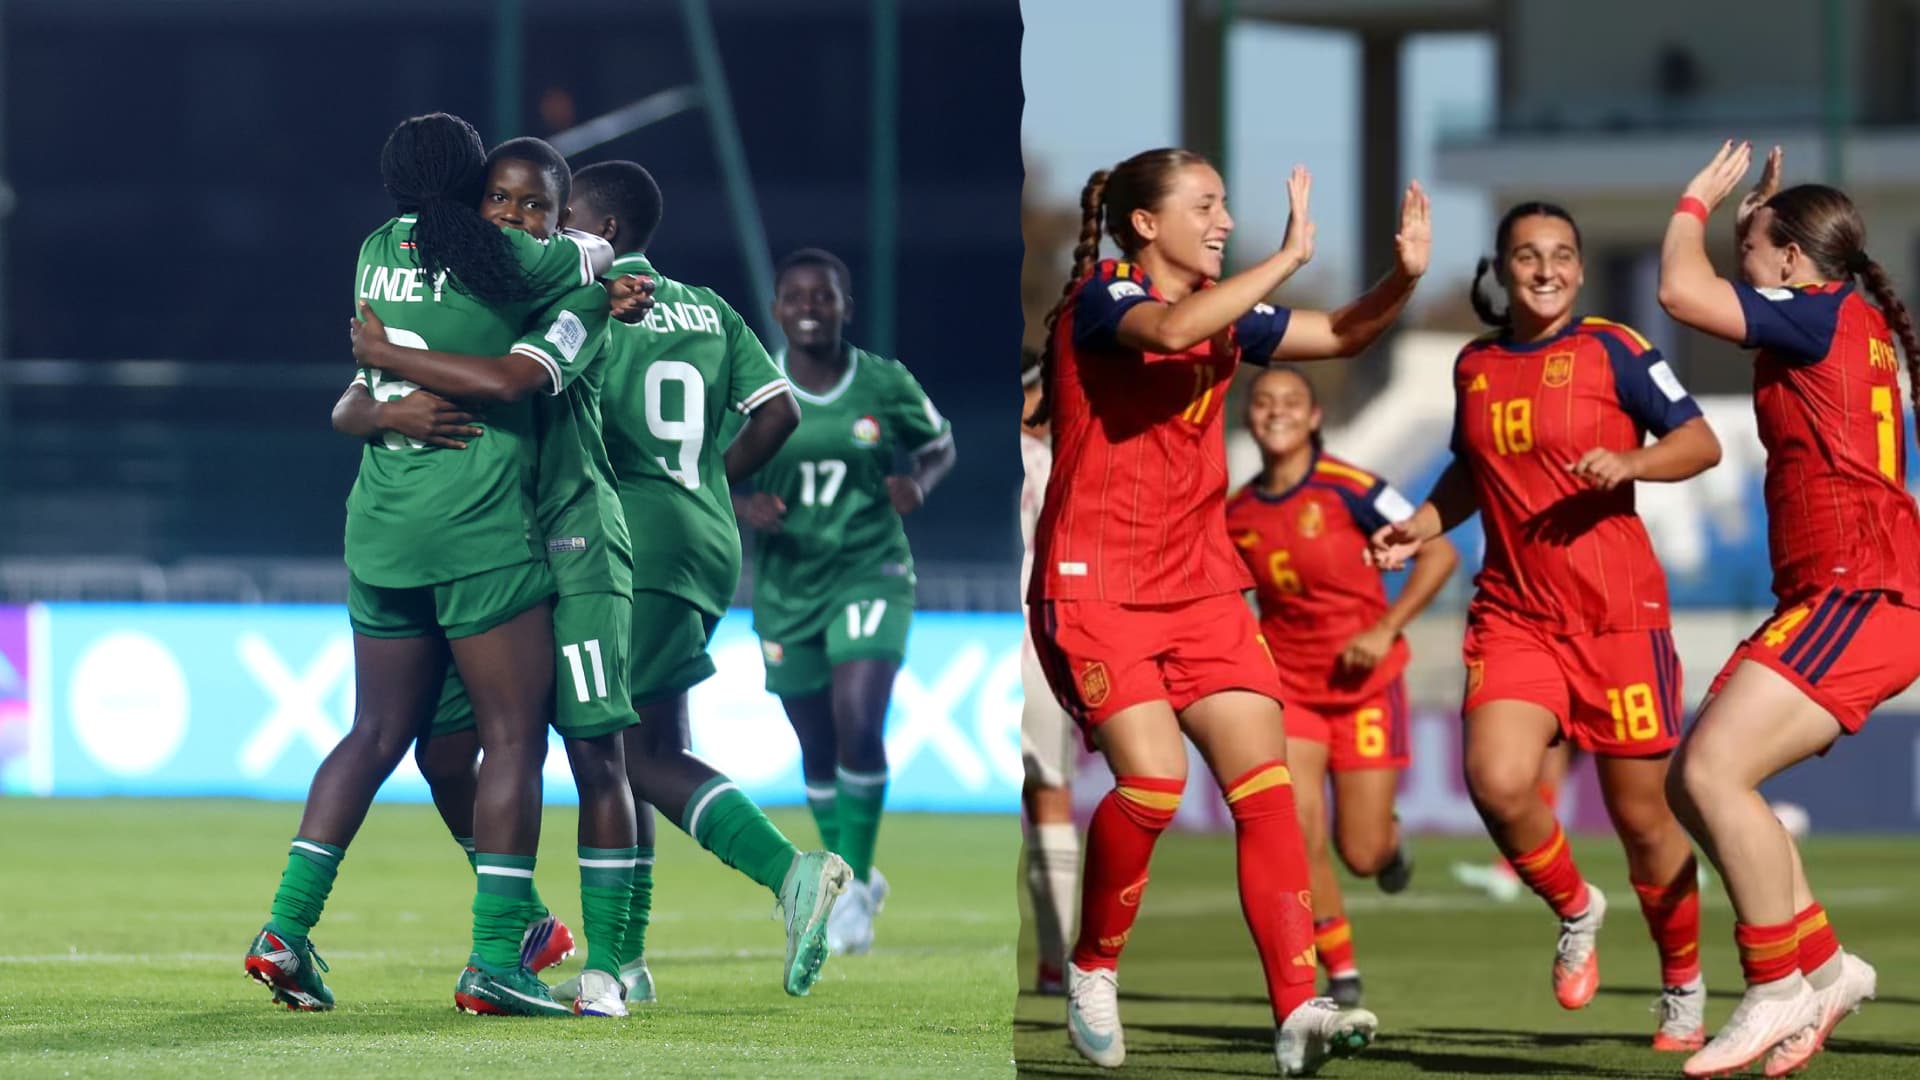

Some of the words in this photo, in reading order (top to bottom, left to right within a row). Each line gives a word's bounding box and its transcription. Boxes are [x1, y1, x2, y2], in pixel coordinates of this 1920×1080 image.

[624, 301, 720, 336] ENDA
[645, 361, 704, 489] 9
[1490, 398, 1533, 455] 18
[799, 459, 847, 506] 17
[846, 598, 888, 639] 17
[562, 639, 607, 703] 11
[1356, 708, 1385, 757] 6
[1606, 683, 1658, 744] 18
